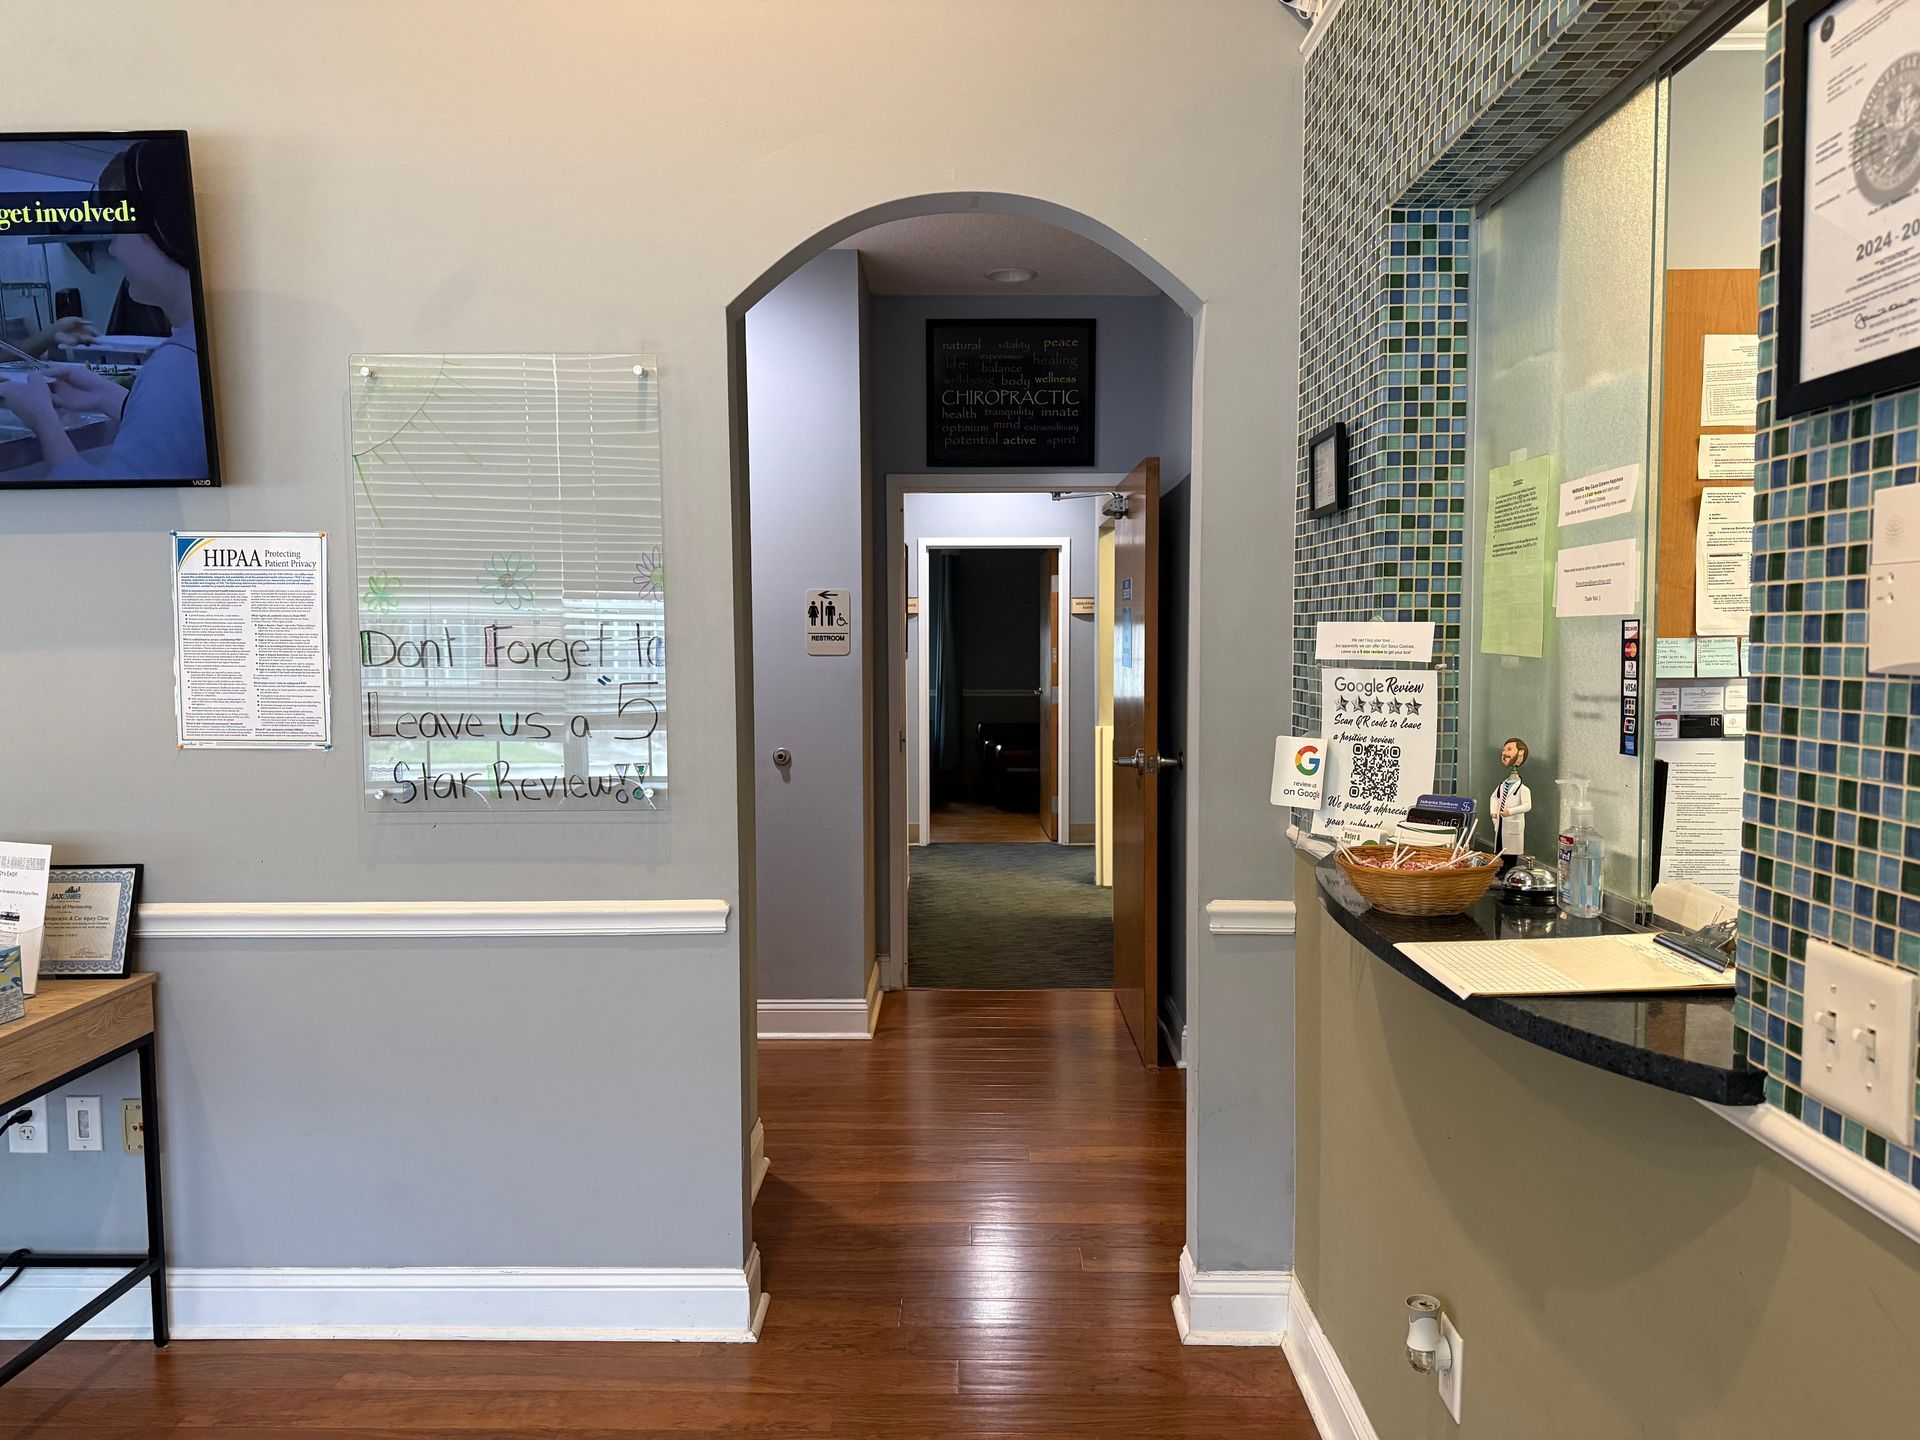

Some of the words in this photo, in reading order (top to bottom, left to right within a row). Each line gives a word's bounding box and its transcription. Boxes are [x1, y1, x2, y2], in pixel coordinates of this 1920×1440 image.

[0, 205, 32, 231] get
[35, 200, 136, 223] involved:
[942, 337, 981, 350] natural
[998, 337, 1031, 352] vitality
[1044, 338, 1079, 352] peace
[982, 361, 1023, 373] balance
[1033, 352, 1079, 369] healing
[1001, 374, 1031, 389] body
[1034, 372, 1077, 384] wellness
[941, 389, 1080, 405] CHIROPRACTIC
[942, 407, 977, 419] health
[984, 407, 1034, 420] tranquility
[1040, 407, 1079, 417] innate
[992, 418, 1021, 430] mind
[1023, 421, 1080, 433] extraordinary
[944, 432, 998, 449] potential
[1003, 435, 1037, 445] active
[1045, 435, 1076, 448] spirit
[203, 549, 262, 567] HIPAA
[264, 549, 301, 559] Protecting
[265, 560, 290, 568] Patient
[290, 560, 317, 570] Privacy
[360, 626, 456, 667] Dont
[484, 623, 612, 681] Forget
[630, 623, 665, 667] to
[1334, 676, 1384, 697] Google
[1385, 676, 1424, 696] Review
[1625, 683, 1637, 692] VISA
[367, 691, 485, 740] Leave
[499, 712, 552, 739] us
[570, 715, 593, 739] a
[614, 682, 659, 740] 5
[1334, 712, 1354, 726] Scan
[1355, 715, 1371, 730] QR
[1371, 717, 1388, 728] code
[1389, 719, 1398, 728] to
[1400, 717, 1422, 730] leave
[1710, 717, 1720, 726] IR
[1339, 731, 1367, 743] positive
[1295, 745, 1320, 776] G
[393, 760, 485, 804] Star
[1283, 788, 1296, 796] on
[1297, 788, 1320, 801] Google
[1327, 794, 1342, 808] We
[1342, 800, 1372, 815] greatly
[1373, 803, 1408, 816] apprecia
[1324, 817, 1345, 828] your
